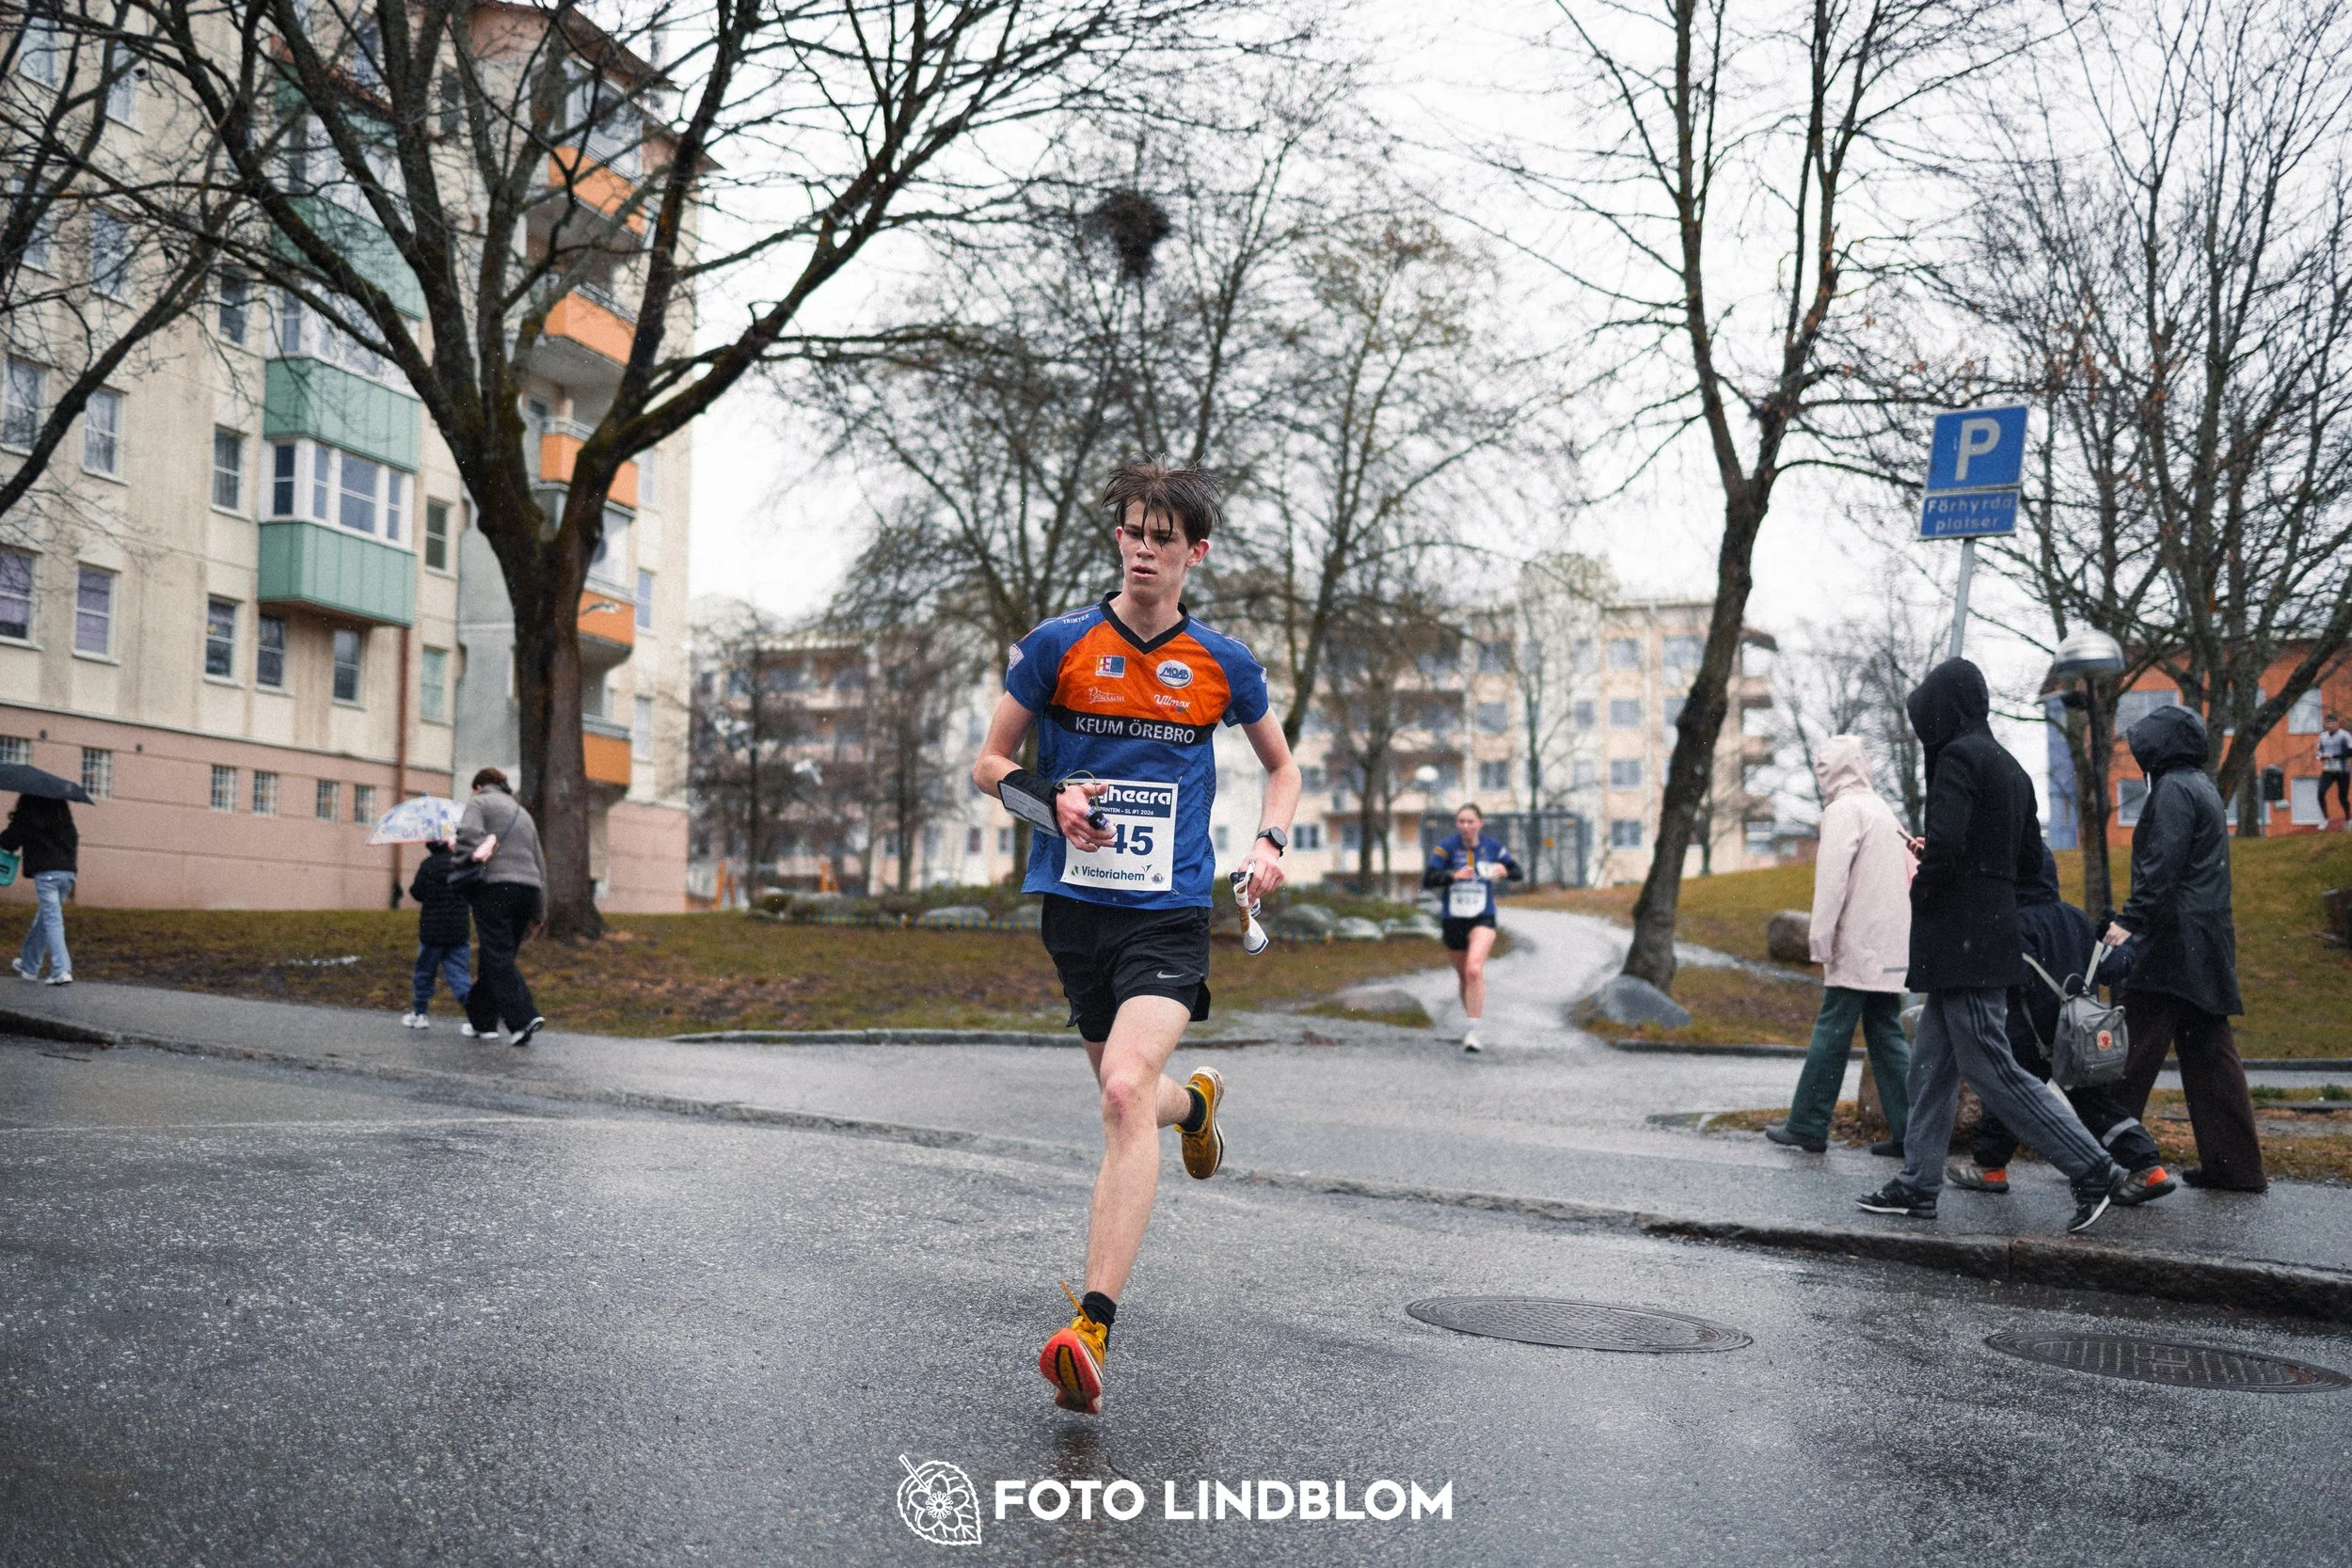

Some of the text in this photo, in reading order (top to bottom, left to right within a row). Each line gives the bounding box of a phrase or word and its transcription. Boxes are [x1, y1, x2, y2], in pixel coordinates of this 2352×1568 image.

[1955, 418, 2000, 482] P
[1927, 495, 2012, 515] Förhyrda
[1935, 515, 1999, 533] platser
[1063, 613, 1089, 625] TRIMTEX
[1159, 666, 1189, 680] MOAB
[1153, 693, 1190, 708] Ullmax
[1075, 716, 1196, 744] KFUM ÖREBRO
[1098, 785, 1172, 805] gheera
[1081, 865, 1145, 881] Victoriahem
